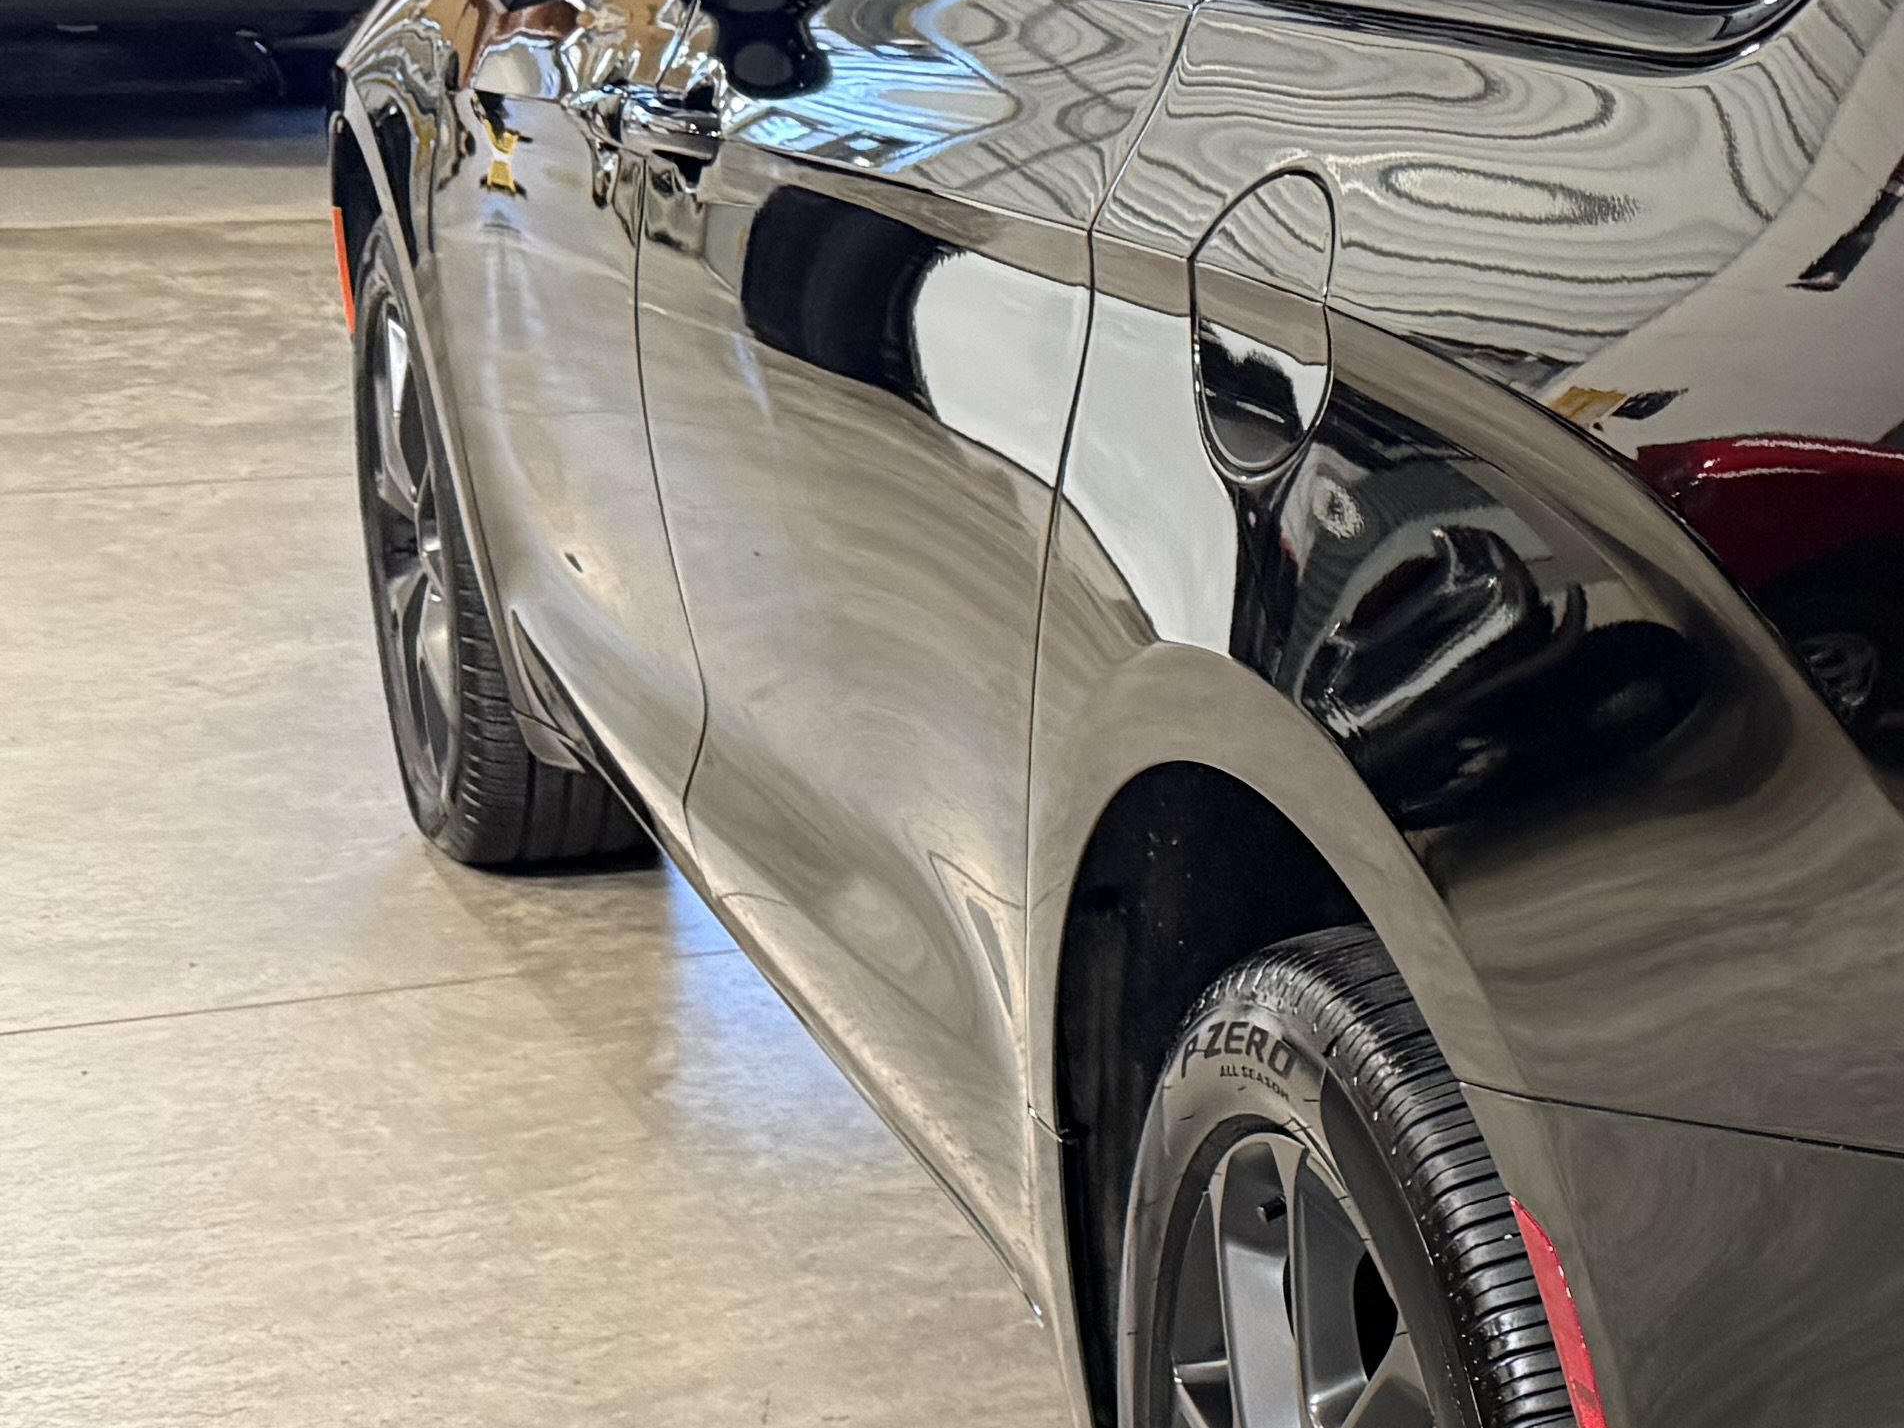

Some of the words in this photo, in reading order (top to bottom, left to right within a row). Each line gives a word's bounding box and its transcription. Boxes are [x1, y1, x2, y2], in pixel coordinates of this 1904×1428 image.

[1204, 1020, 1297, 1080] ZERO
[1220, 1065, 1239, 1077] ALL
[1241, 1065, 1290, 1102] SEASON
